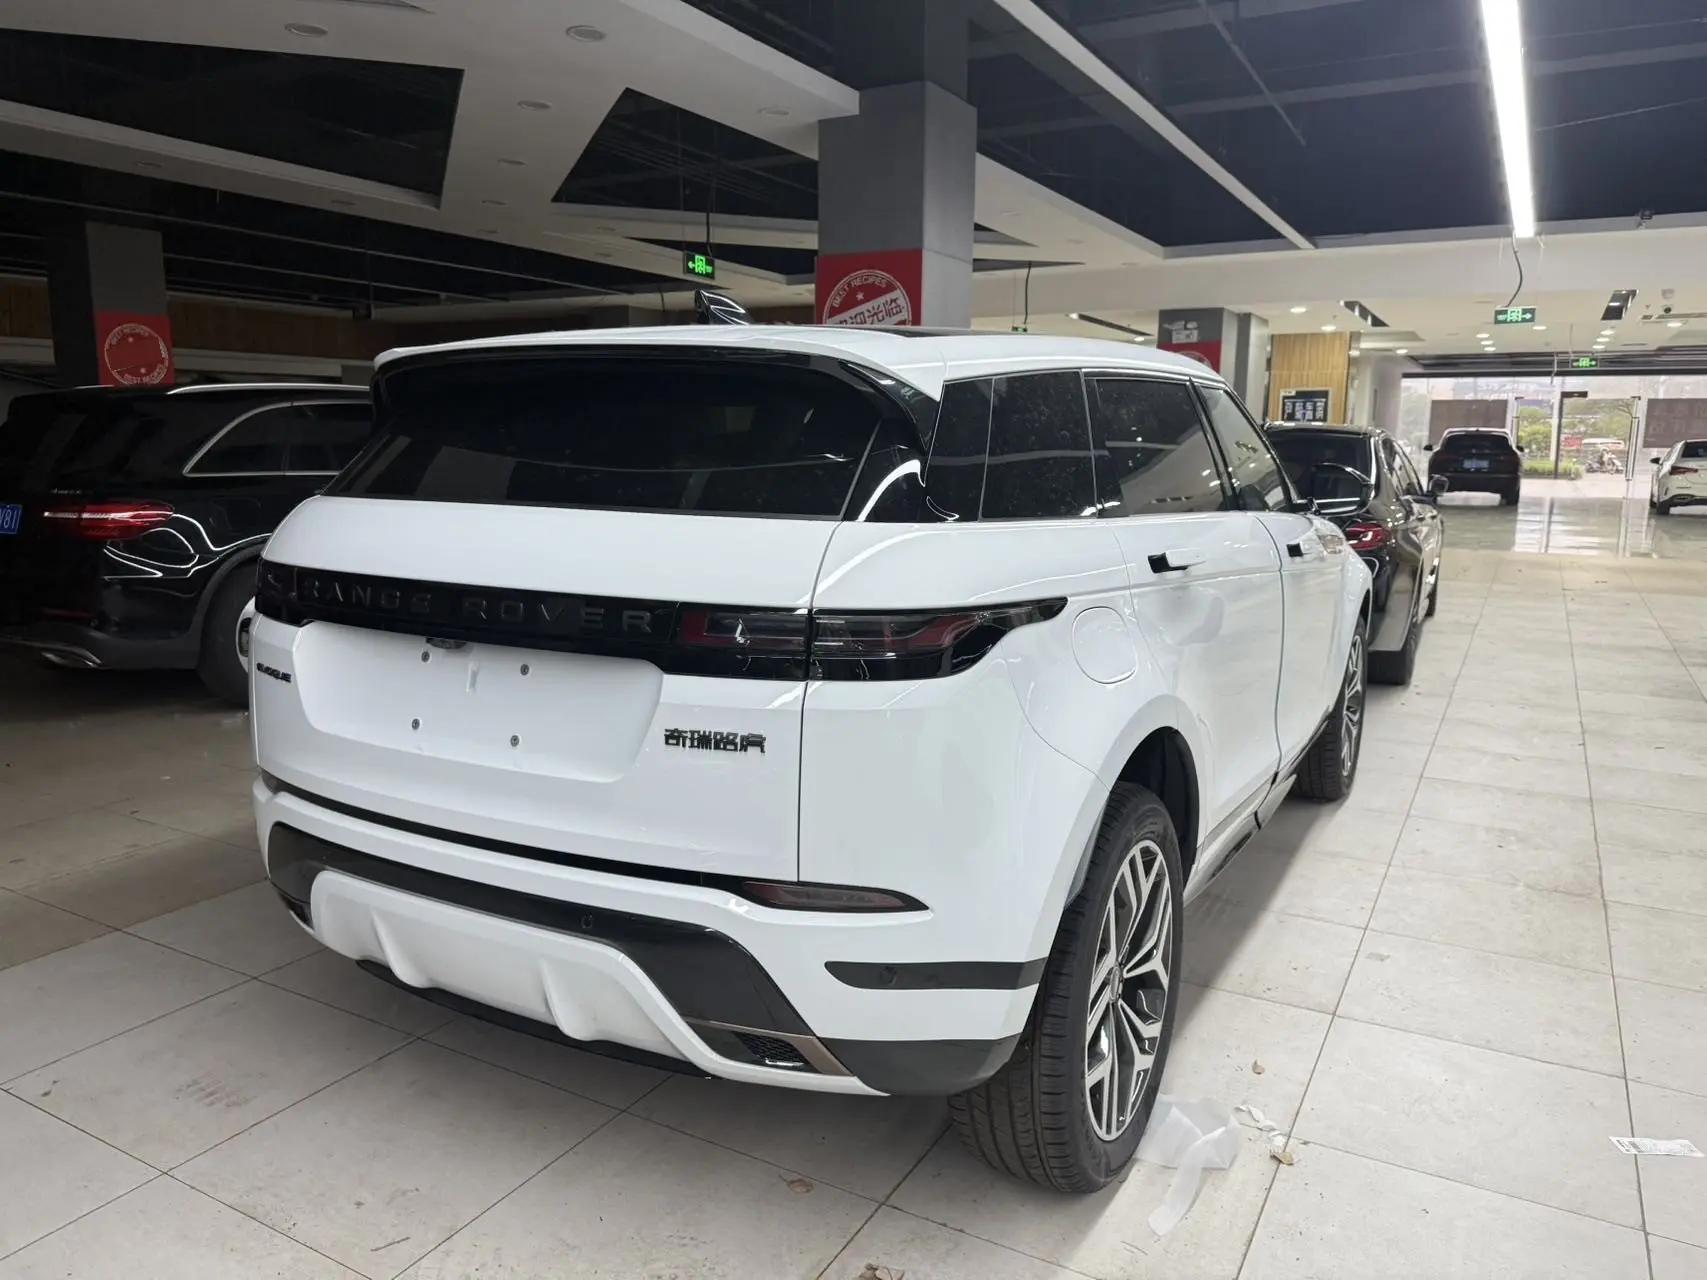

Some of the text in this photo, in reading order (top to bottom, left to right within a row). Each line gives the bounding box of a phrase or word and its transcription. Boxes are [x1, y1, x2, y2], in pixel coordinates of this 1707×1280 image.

[839, 297, 904, 325] 迎光临
[304, 578, 652, 633] RANGE ROVER
[664, 728, 766, 753] 奇瑞路虎
